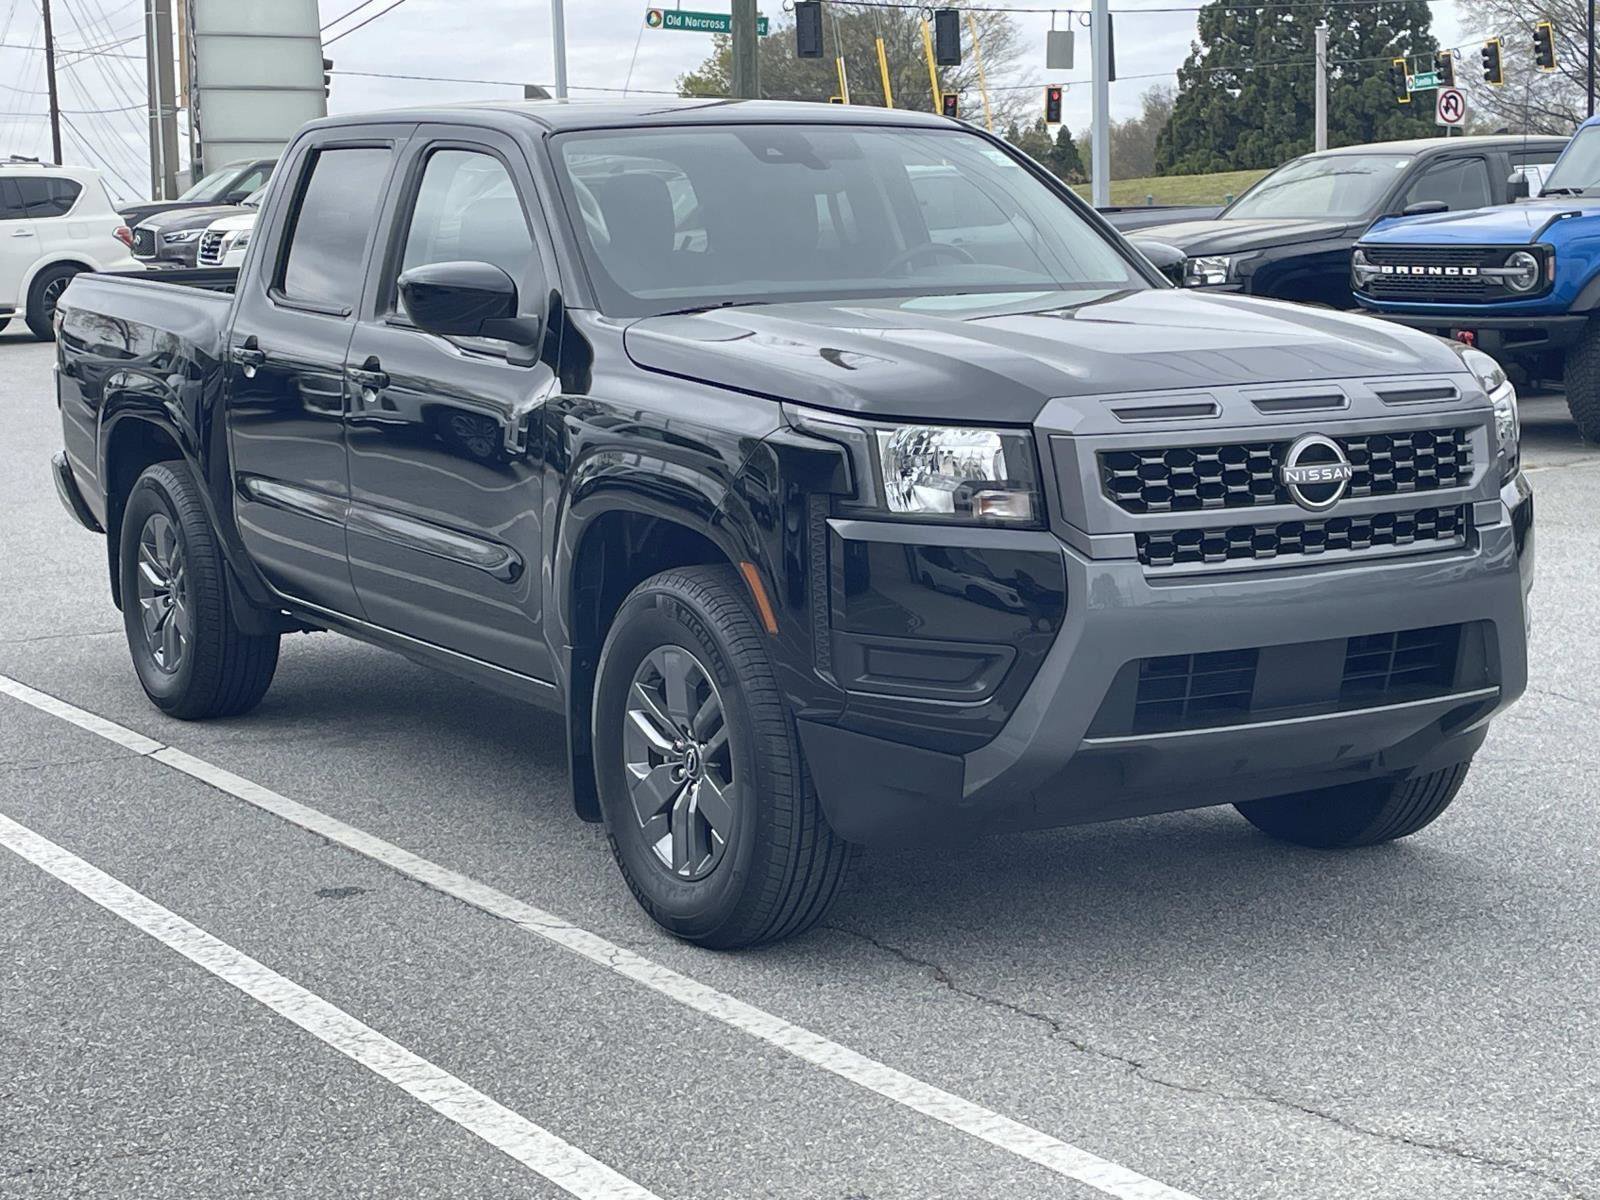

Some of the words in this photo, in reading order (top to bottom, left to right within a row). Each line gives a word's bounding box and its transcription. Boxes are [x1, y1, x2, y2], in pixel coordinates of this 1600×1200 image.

[666, 14, 682, 26] Old
[685, 17, 725, 29] Norcross
[1381, 265, 1478, 276] BRONCO
[1285, 466, 1353, 482] NISSAN
